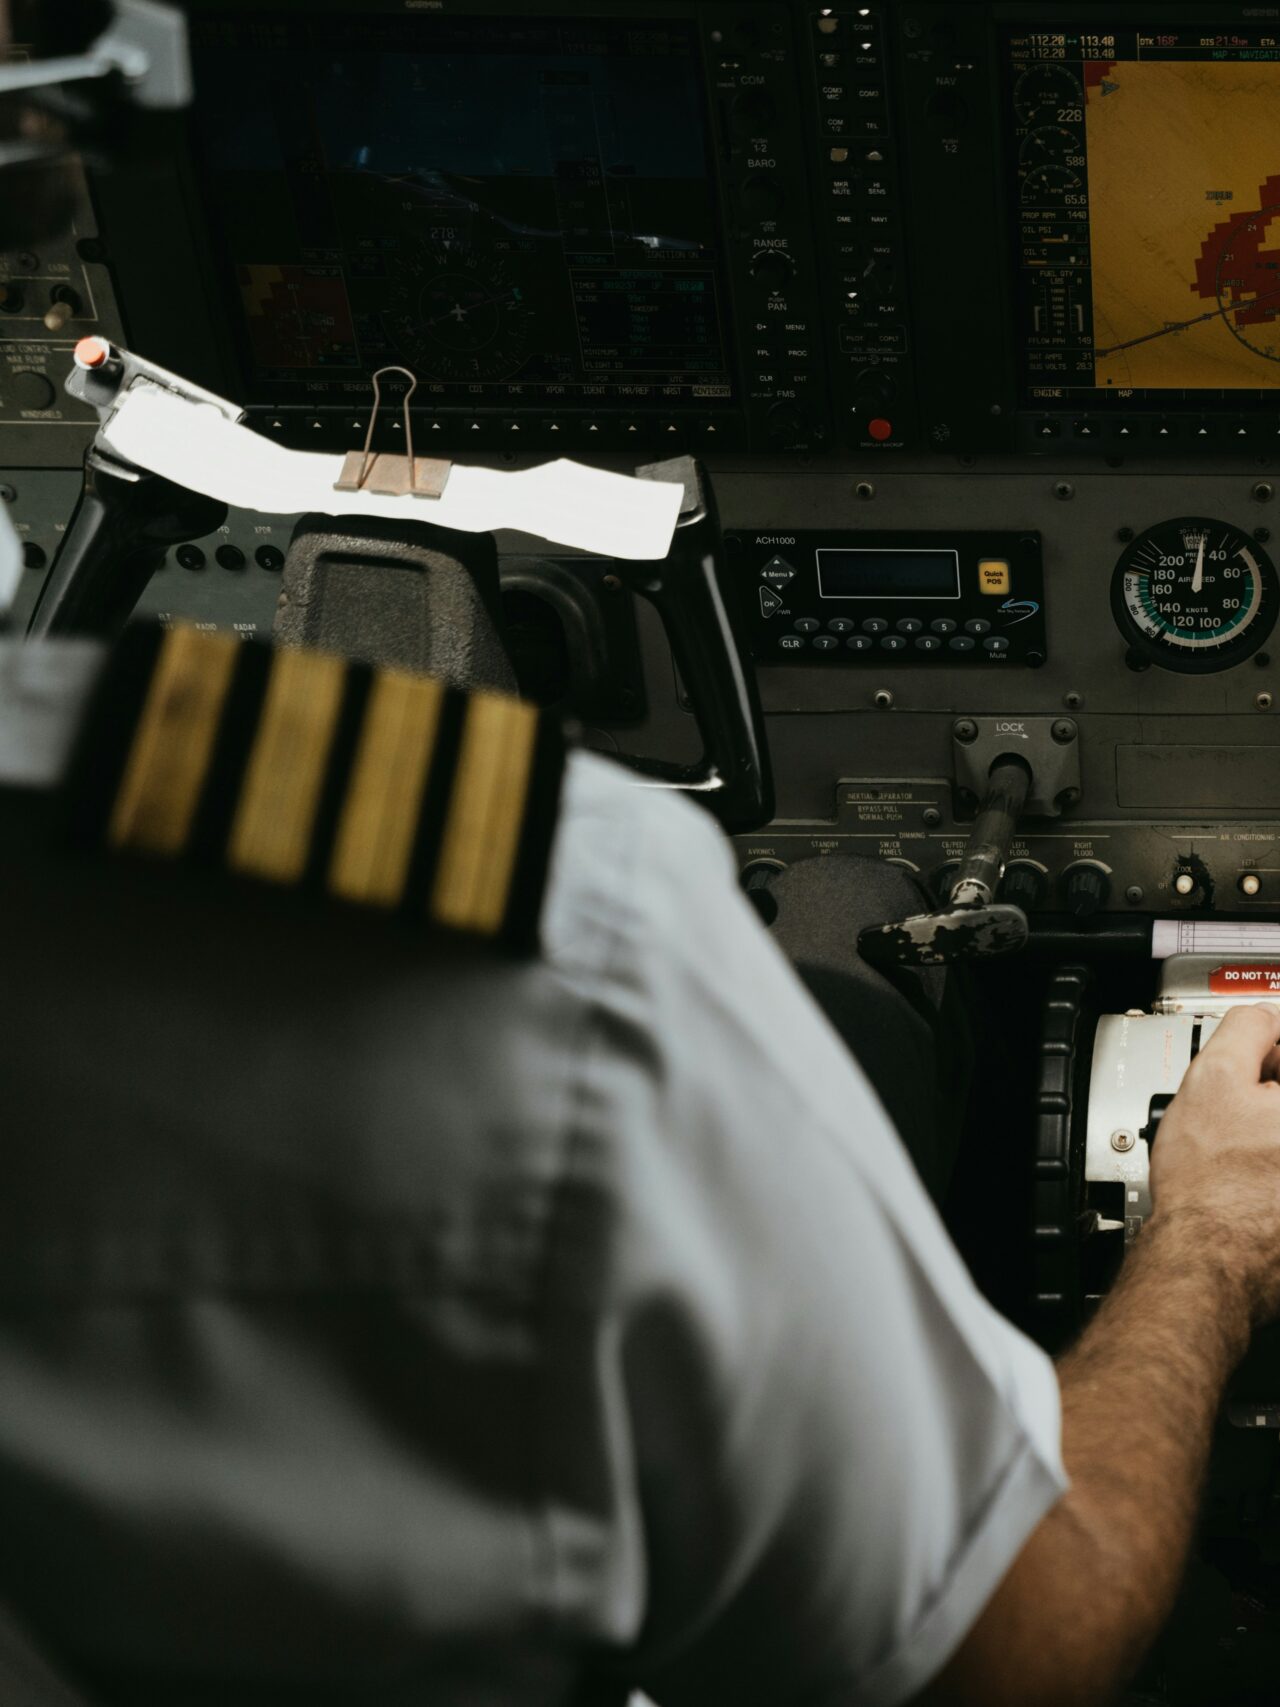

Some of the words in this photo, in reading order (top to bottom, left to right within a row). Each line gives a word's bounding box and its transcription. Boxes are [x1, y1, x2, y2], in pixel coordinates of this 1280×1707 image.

[1030, 36, 1065, 46] 112.20
[1080, 36, 1114, 47] 113.40
[1031, 48, 1065, 58] 112.20
[1081, 48, 1114, 58] 113.40
[740, 76, 765, 84] COM
[936, 77, 956, 85] NAV
[1057, 110, 1082, 122] 228
[748, 160, 776, 168] BARO
[1066, 157, 1085, 166] 588
[1065, 195, 1086, 204] 65.6
[753, 240, 788, 248] RANGE
[768, 303, 786, 311] PAN
[777, 390, 795, 398] FMS
[1033, 389, 1062, 397] ENGINE
[1118, 389, 1133, 397] MAP
[755, 536, 795, 545] ACH1000
[1209, 551, 1227, 560] 40
[1159, 556, 1184, 566] 200
[984, 571, 1003, 579] Quick
[1154, 570, 1175, 579] 180
[1223, 568, 1240, 578] 60
[1152, 585, 1172, 594] 160
[1159, 603, 1180, 612] 140
[1223, 599, 1239, 608] 80
[1173, 617, 1194, 626] 120
[1200, 618, 1221, 627] 100
[907, 623, 912, 631] 4
[942, 623, 947, 631] 5
[823, 640, 828, 648] 7
[857, 640, 862, 648] 8
[891, 640, 897, 648] 9
[997, 723, 1024, 731] LOCK
[1242, 972, 1262, 980] NOT
